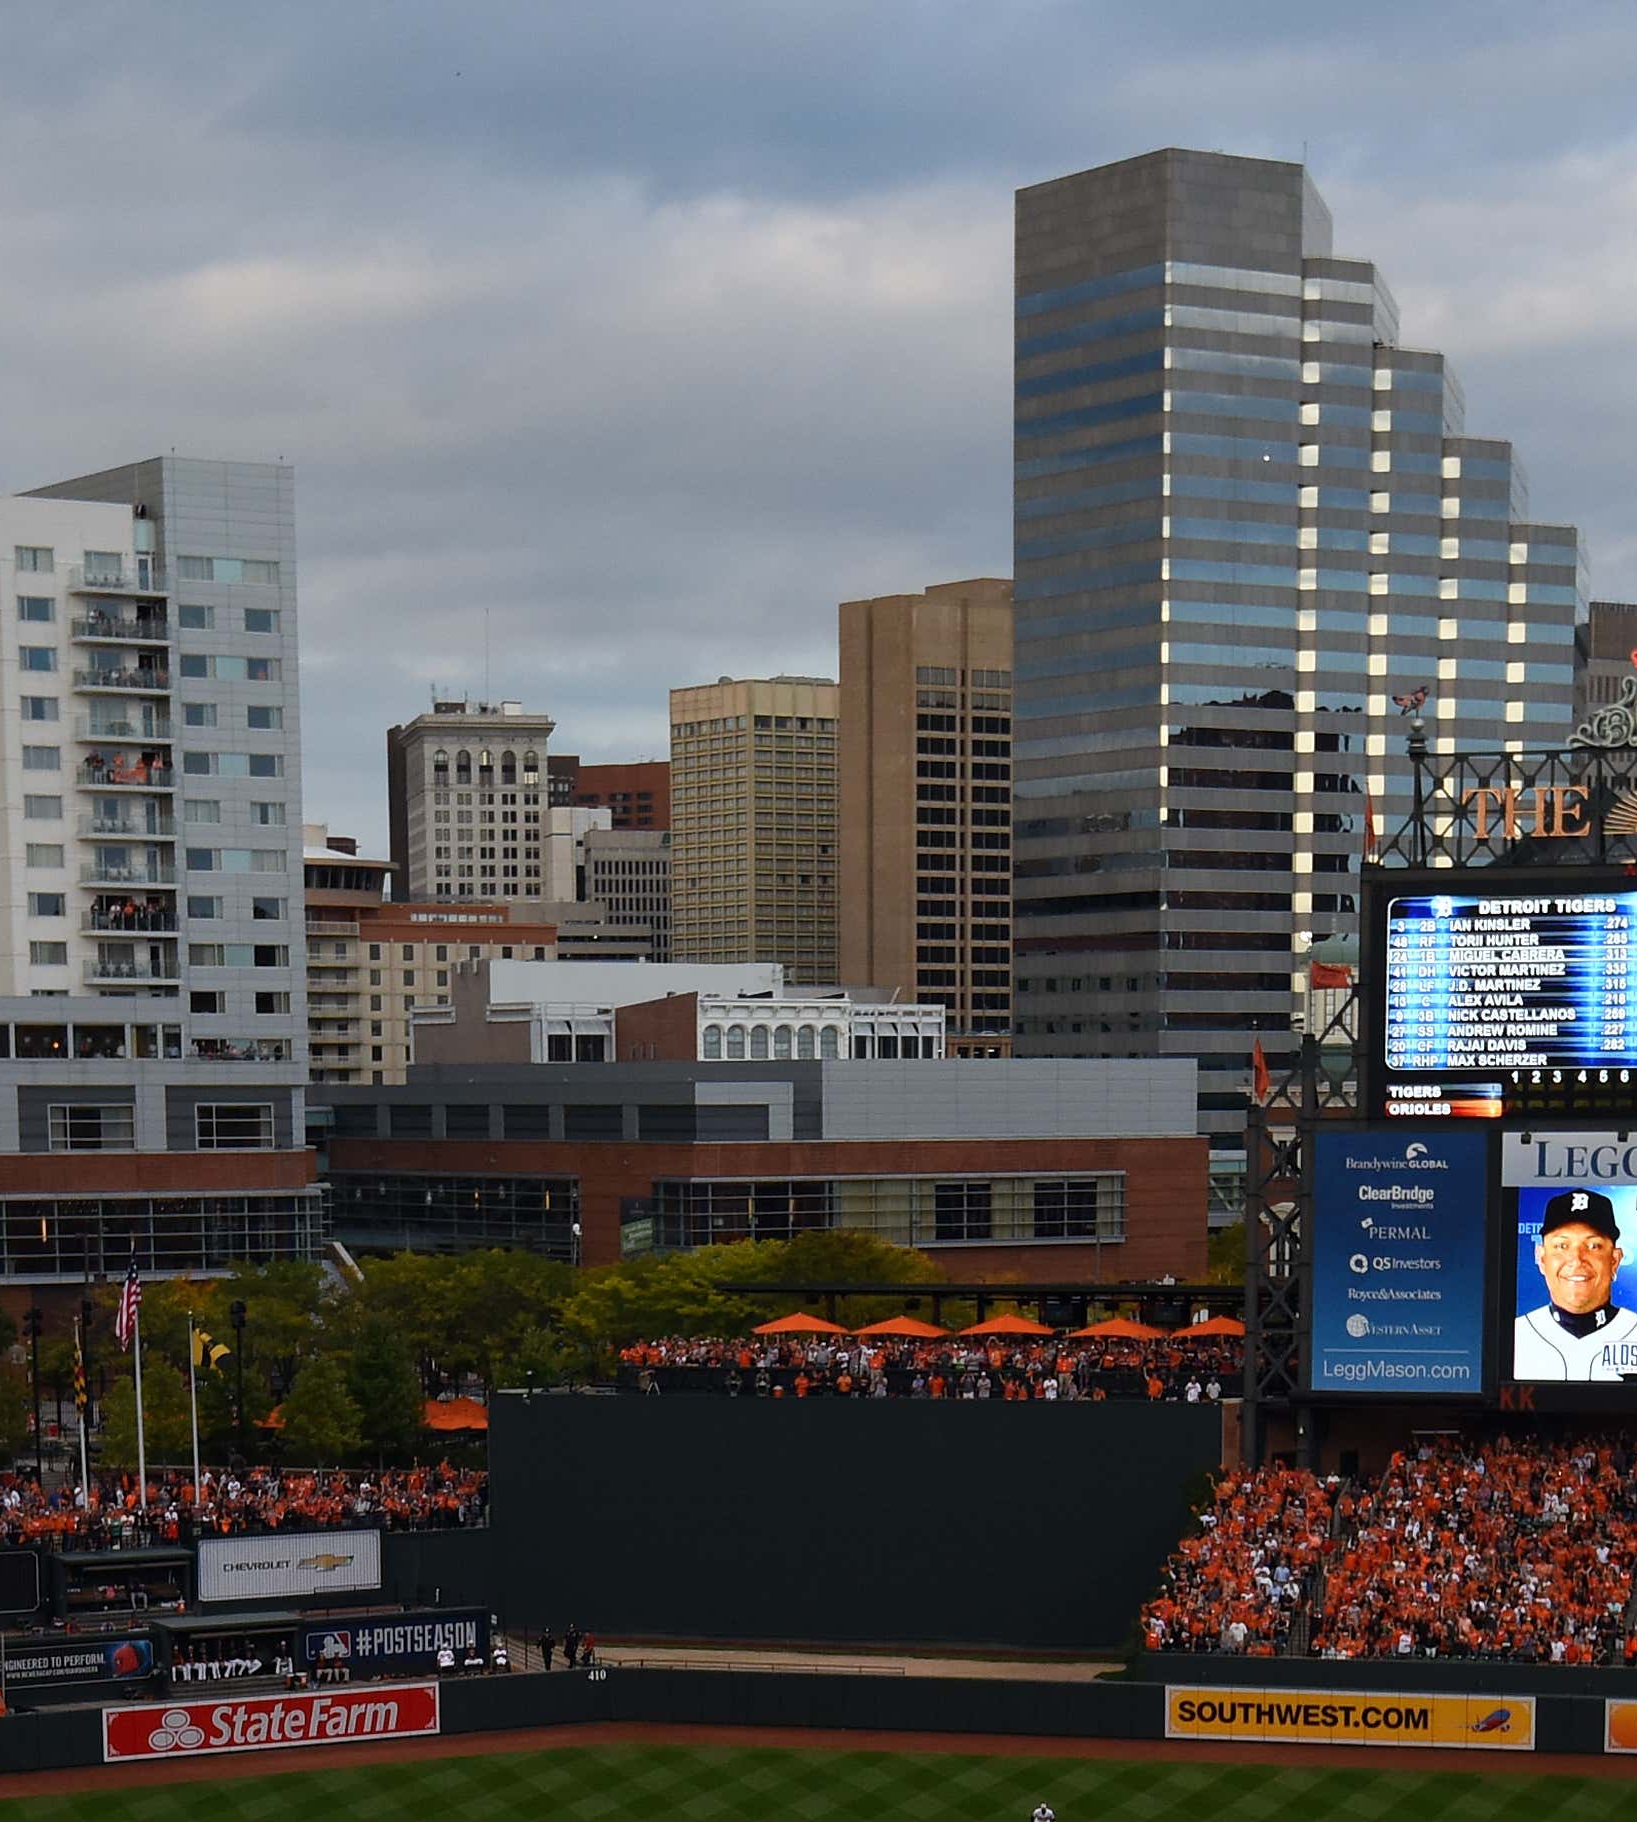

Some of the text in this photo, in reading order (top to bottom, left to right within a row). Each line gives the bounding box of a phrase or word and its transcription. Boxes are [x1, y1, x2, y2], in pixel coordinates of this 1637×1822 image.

[1460, 785, 1593, 839] THE
[1479, 898, 1616, 915] DETROIT TIGERS
[1449, 918, 1531, 931] IAN KINSLER
[1449, 933, 1539, 947] TORII HUNTER
[1449, 949, 1566, 962] MIGUEL CABRERA
[1449, 963, 1566, 977] VICTOR MARTINEZ
[1448, 979, 1541, 992] J.D. MARTINEZ
[1448, 994, 1523, 1006] ALEX AVILA
[1447, 1008, 1576, 1021] NICK CASTELLANOS
[1447, 1024, 1558, 1036] ANDREW ROMINE
[1447, 1039, 1526, 1052] RAJAI DAVIS
[1446, 1054, 1548, 1066] MAX SCHERZER
[1389, 1085, 1442, 1098] TIGERS
[1388, 1103, 1452, 1115] ORIOLES
[1358, 1185, 1435, 1203] ClearBridge
[1369, 1226, 1431, 1240] PERMAL
[1373, 1256, 1442, 1271] QS Investors
[1323, 1359, 1470, 1381] LeggMason.com
[223, 1559, 291, 1573] CHEVROLET
[355, 1620, 477, 1657] #POSTSEASON
[50, 1655, 62, 1669] TO
[63, 1652, 106, 1668] PERFORM.
[587, 1669, 607, 1681] 410
[1178, 1700, 1430, 1730] SOUTHWEST.COM
